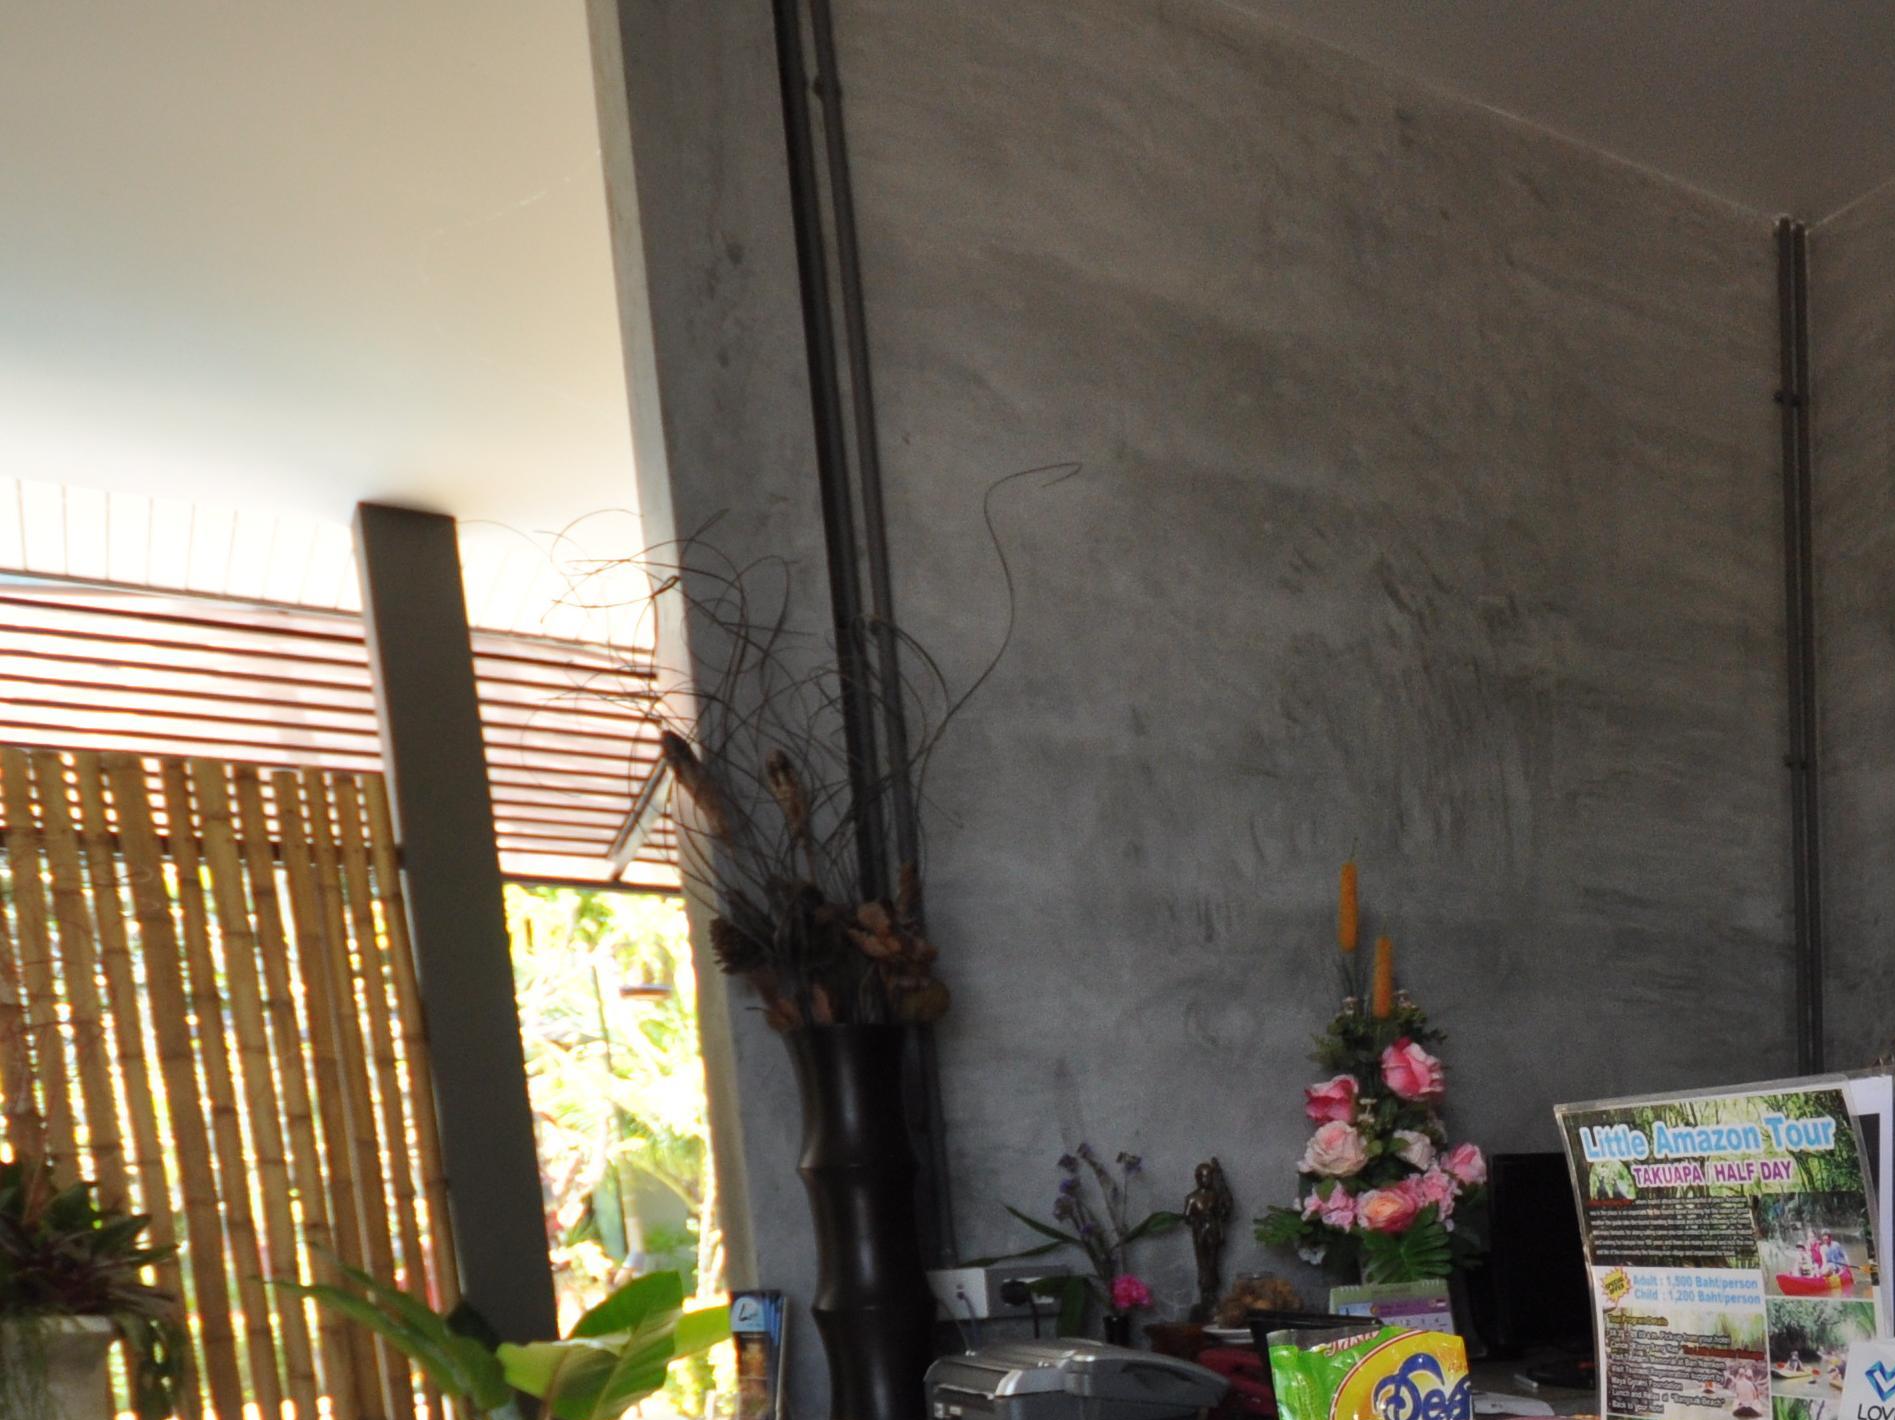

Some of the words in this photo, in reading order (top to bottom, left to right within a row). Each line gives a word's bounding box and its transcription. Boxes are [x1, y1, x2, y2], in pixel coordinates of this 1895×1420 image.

[1581, 1125, 1648, 1160] Little
[1654, 1122, 1761, 1156] Amazon
[1763, 1113, 1835, 1149] Tour
[1633, 1164, 1704, 1186] TAKUAPA
[1715, 1161, 1755, 1182] HALF
[1761, 1160, 1793, 1181] DAY
